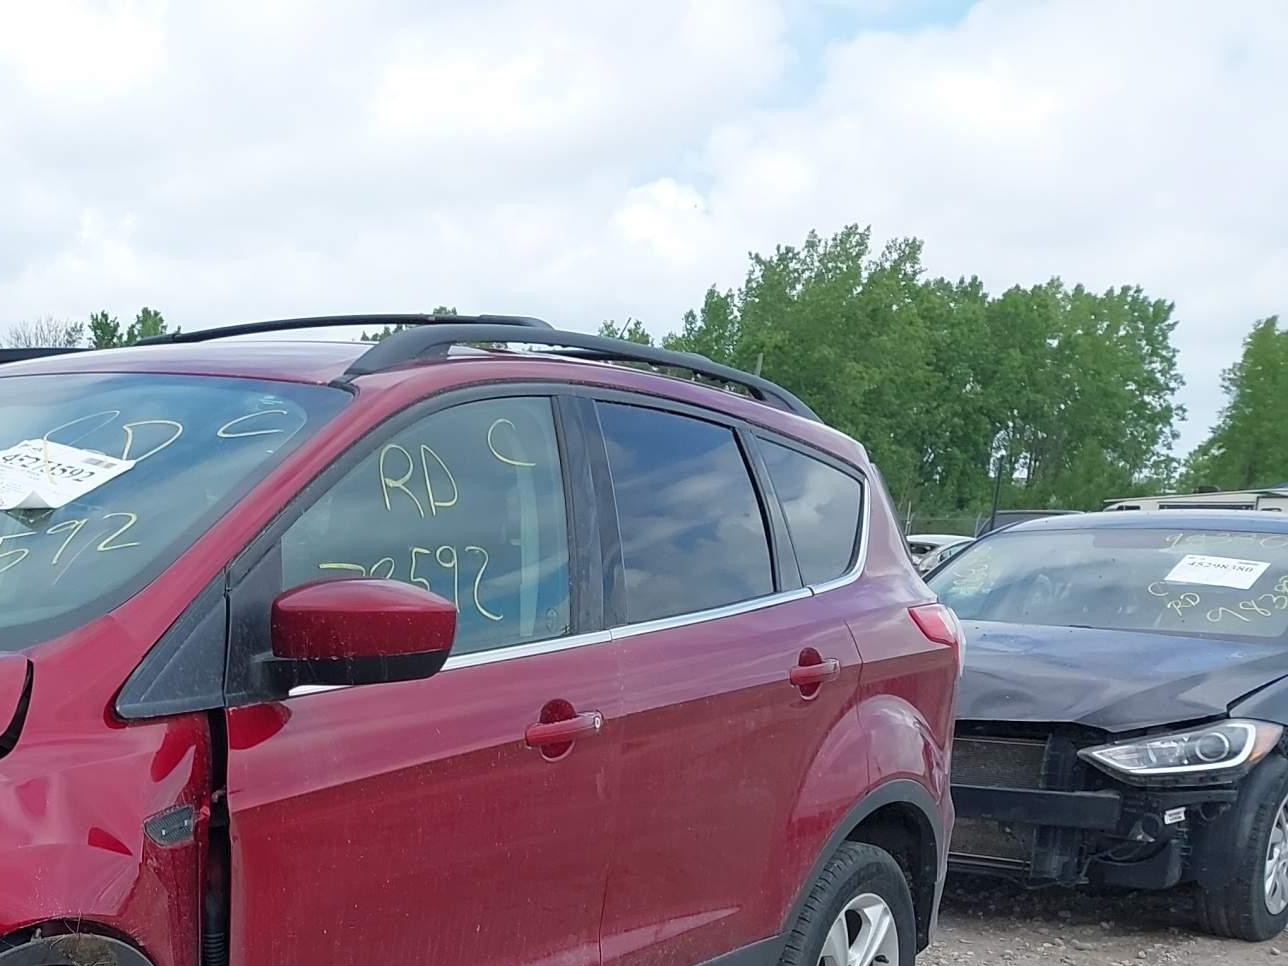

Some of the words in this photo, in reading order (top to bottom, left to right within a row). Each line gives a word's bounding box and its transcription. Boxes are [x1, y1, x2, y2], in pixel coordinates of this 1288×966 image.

[218, 410, 288, 438] C
[379, 444, 458, 519] RD
[487, 418, 536, 467] C
[318, 545, 504, 621] 592
[1148, 581, 1169, 597] C
[1167, 592, 1200, 617] RD
